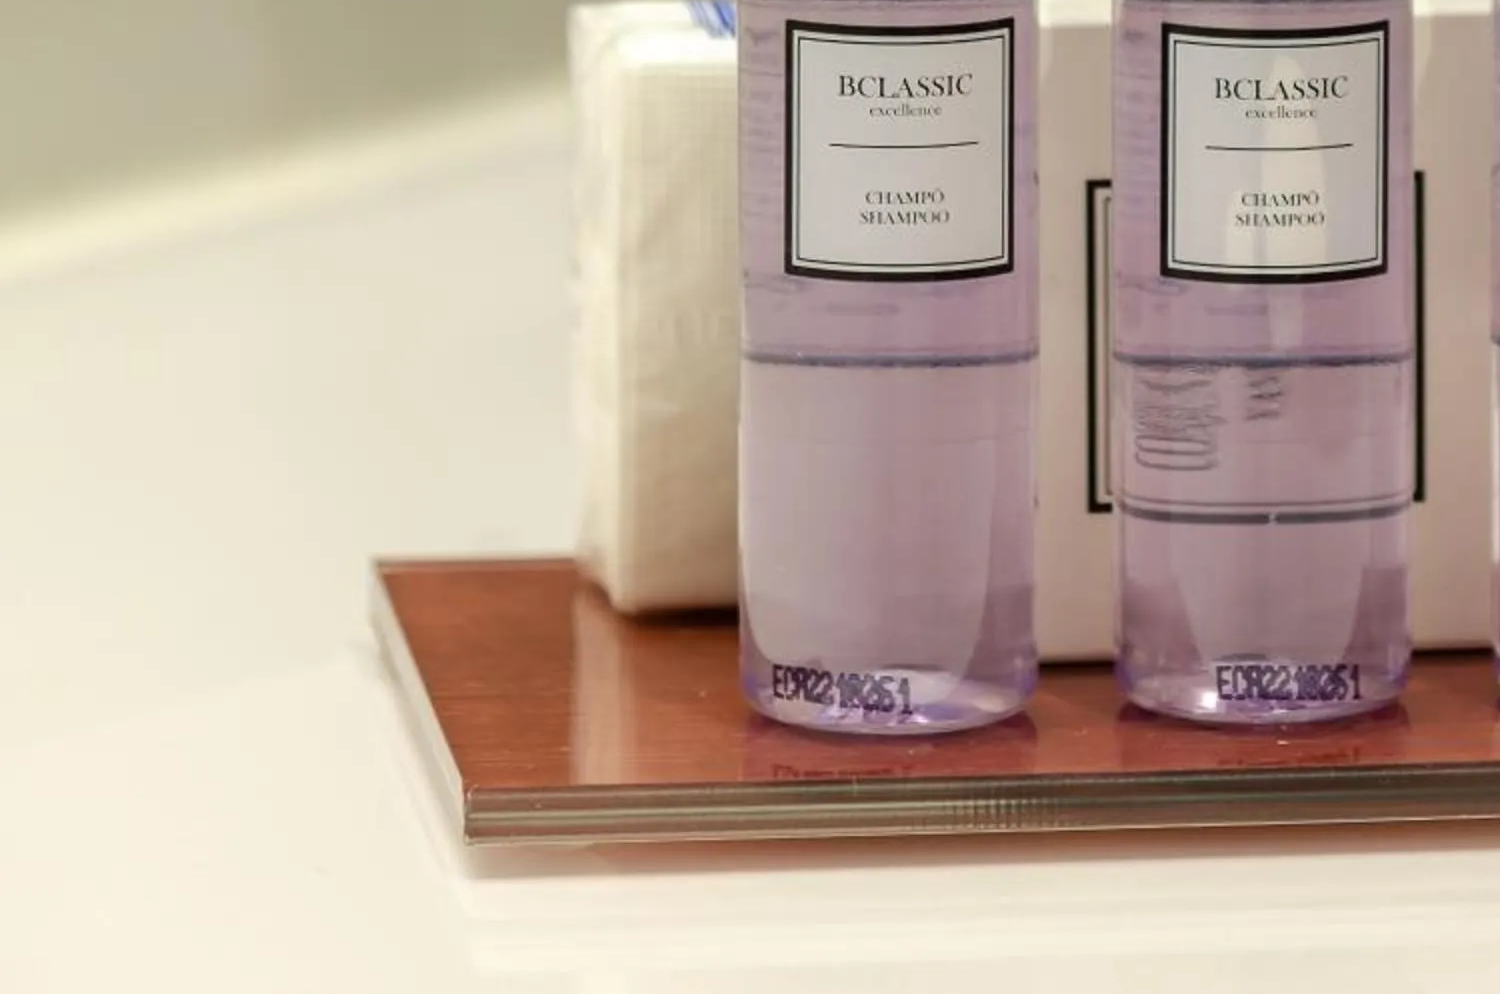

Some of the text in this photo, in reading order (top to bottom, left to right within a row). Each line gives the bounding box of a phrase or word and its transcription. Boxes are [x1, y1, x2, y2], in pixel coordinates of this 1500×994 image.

[838, 73, 973, 98] BCLASSIC
[1215, 75, 1348, 101] BCLASSIC
[869, 103, 942, 117] excellence
[1245, 106, 1317, 119] excellence
[859, 210, 950, 225] SHAMPOO
[1235, 212, 1325, 227] SHAMPOO
